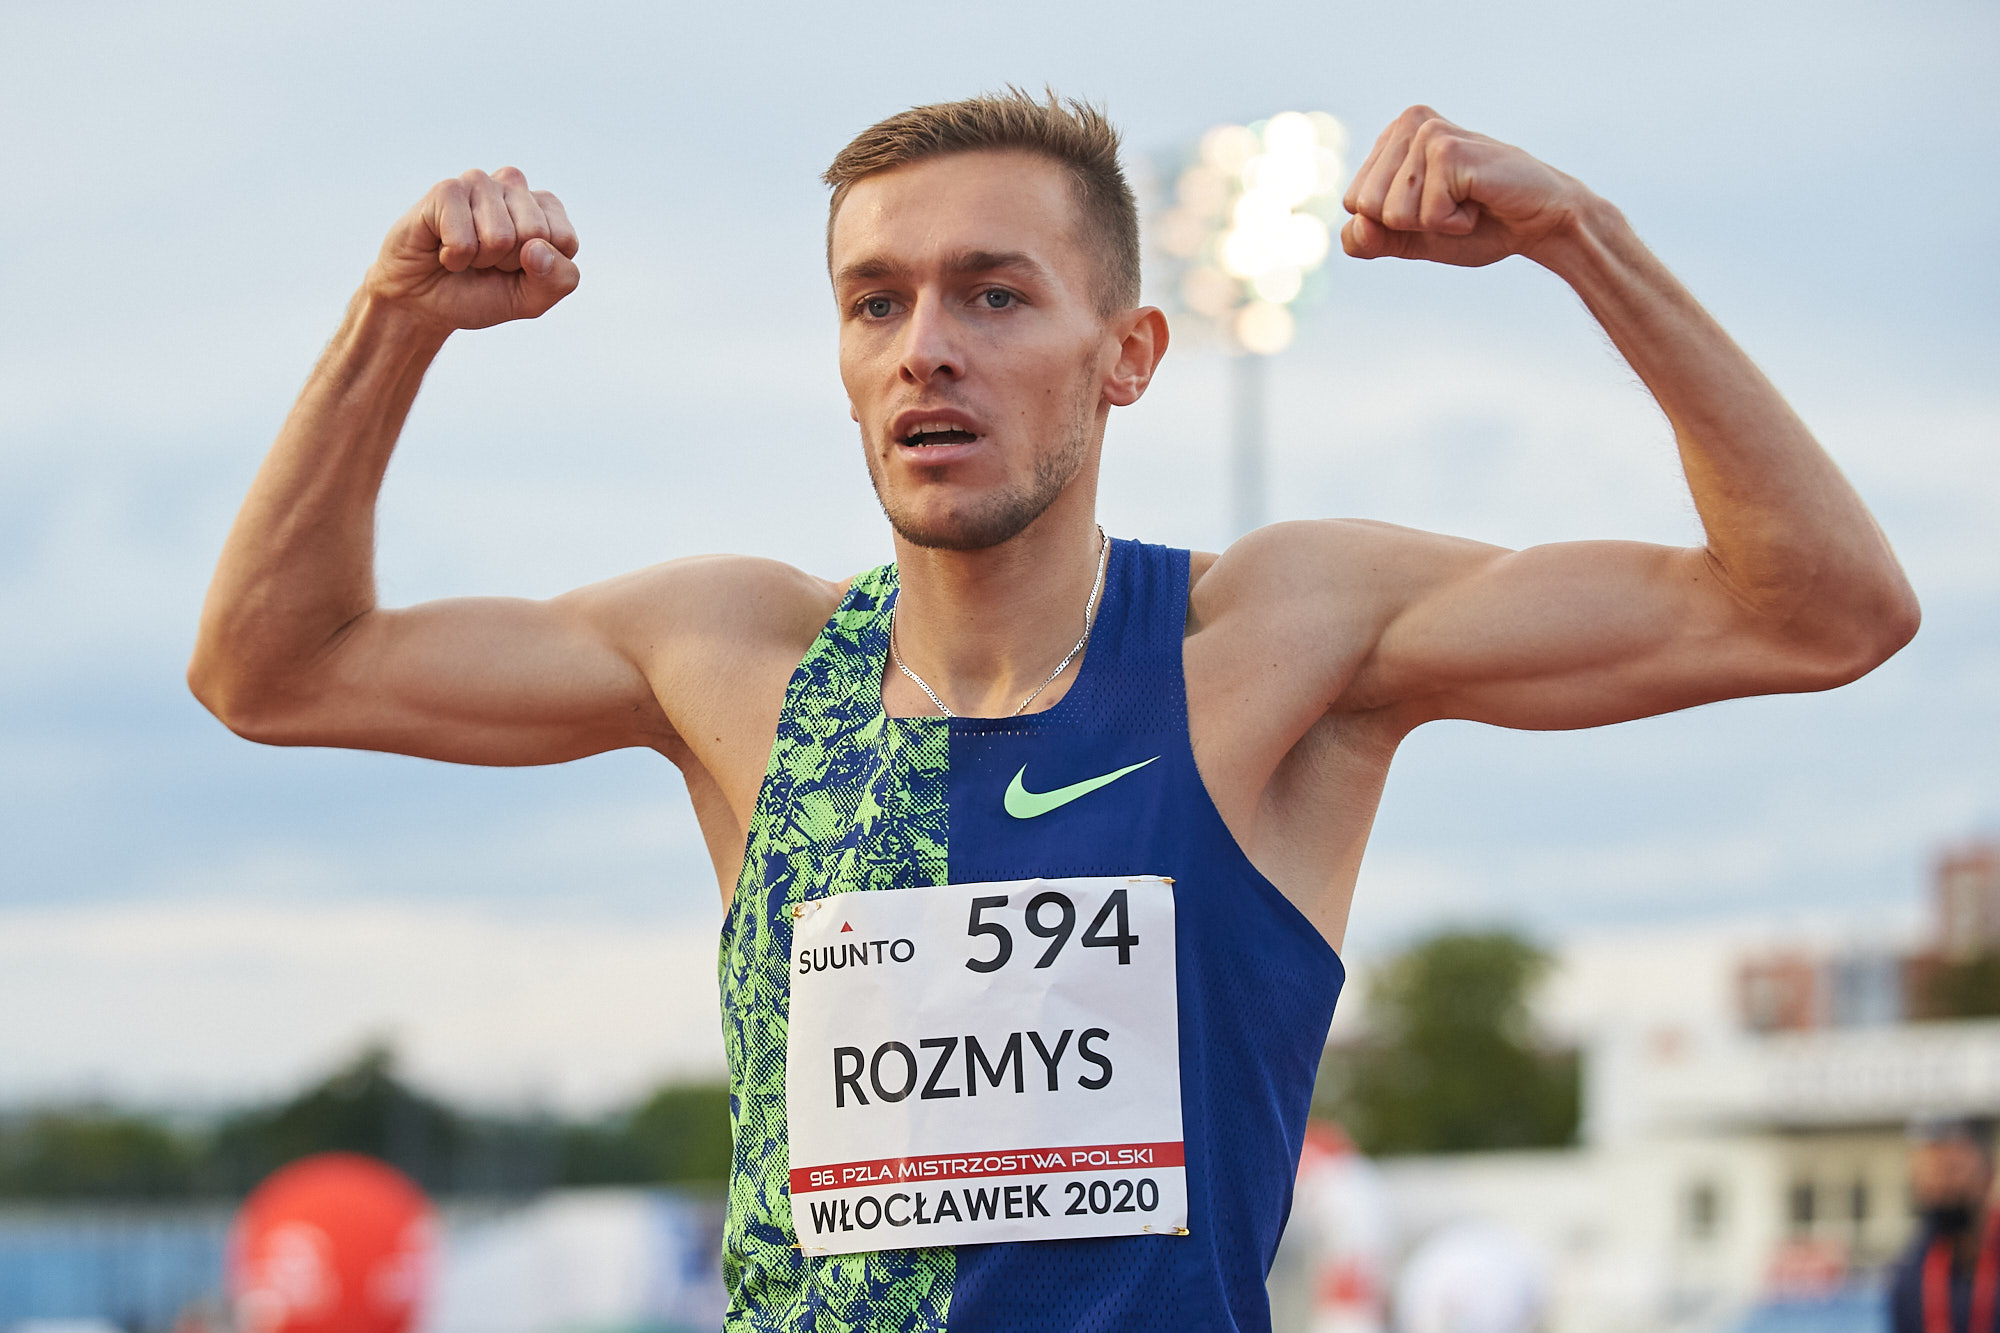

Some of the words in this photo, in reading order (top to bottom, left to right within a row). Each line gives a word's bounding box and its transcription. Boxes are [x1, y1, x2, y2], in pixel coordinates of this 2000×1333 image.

[799, 938, 915, 974] SUUNTO
[965, 889, 1139, 973] 594
[833, 1028, 1113, 1108] ROZMYS
[809, 1168, 838, 1187] 96.
[843, 1164, 893, 1183] PZLA
[898, 1153, 1066, 1178] MISTRZOSTWA
[1072, 1147, 1154, 1166] POLSKI
[810, 1183, 1051, 1234] WŁOCŁAWEK
[1064, 1178, 1159, 1216] 2020
